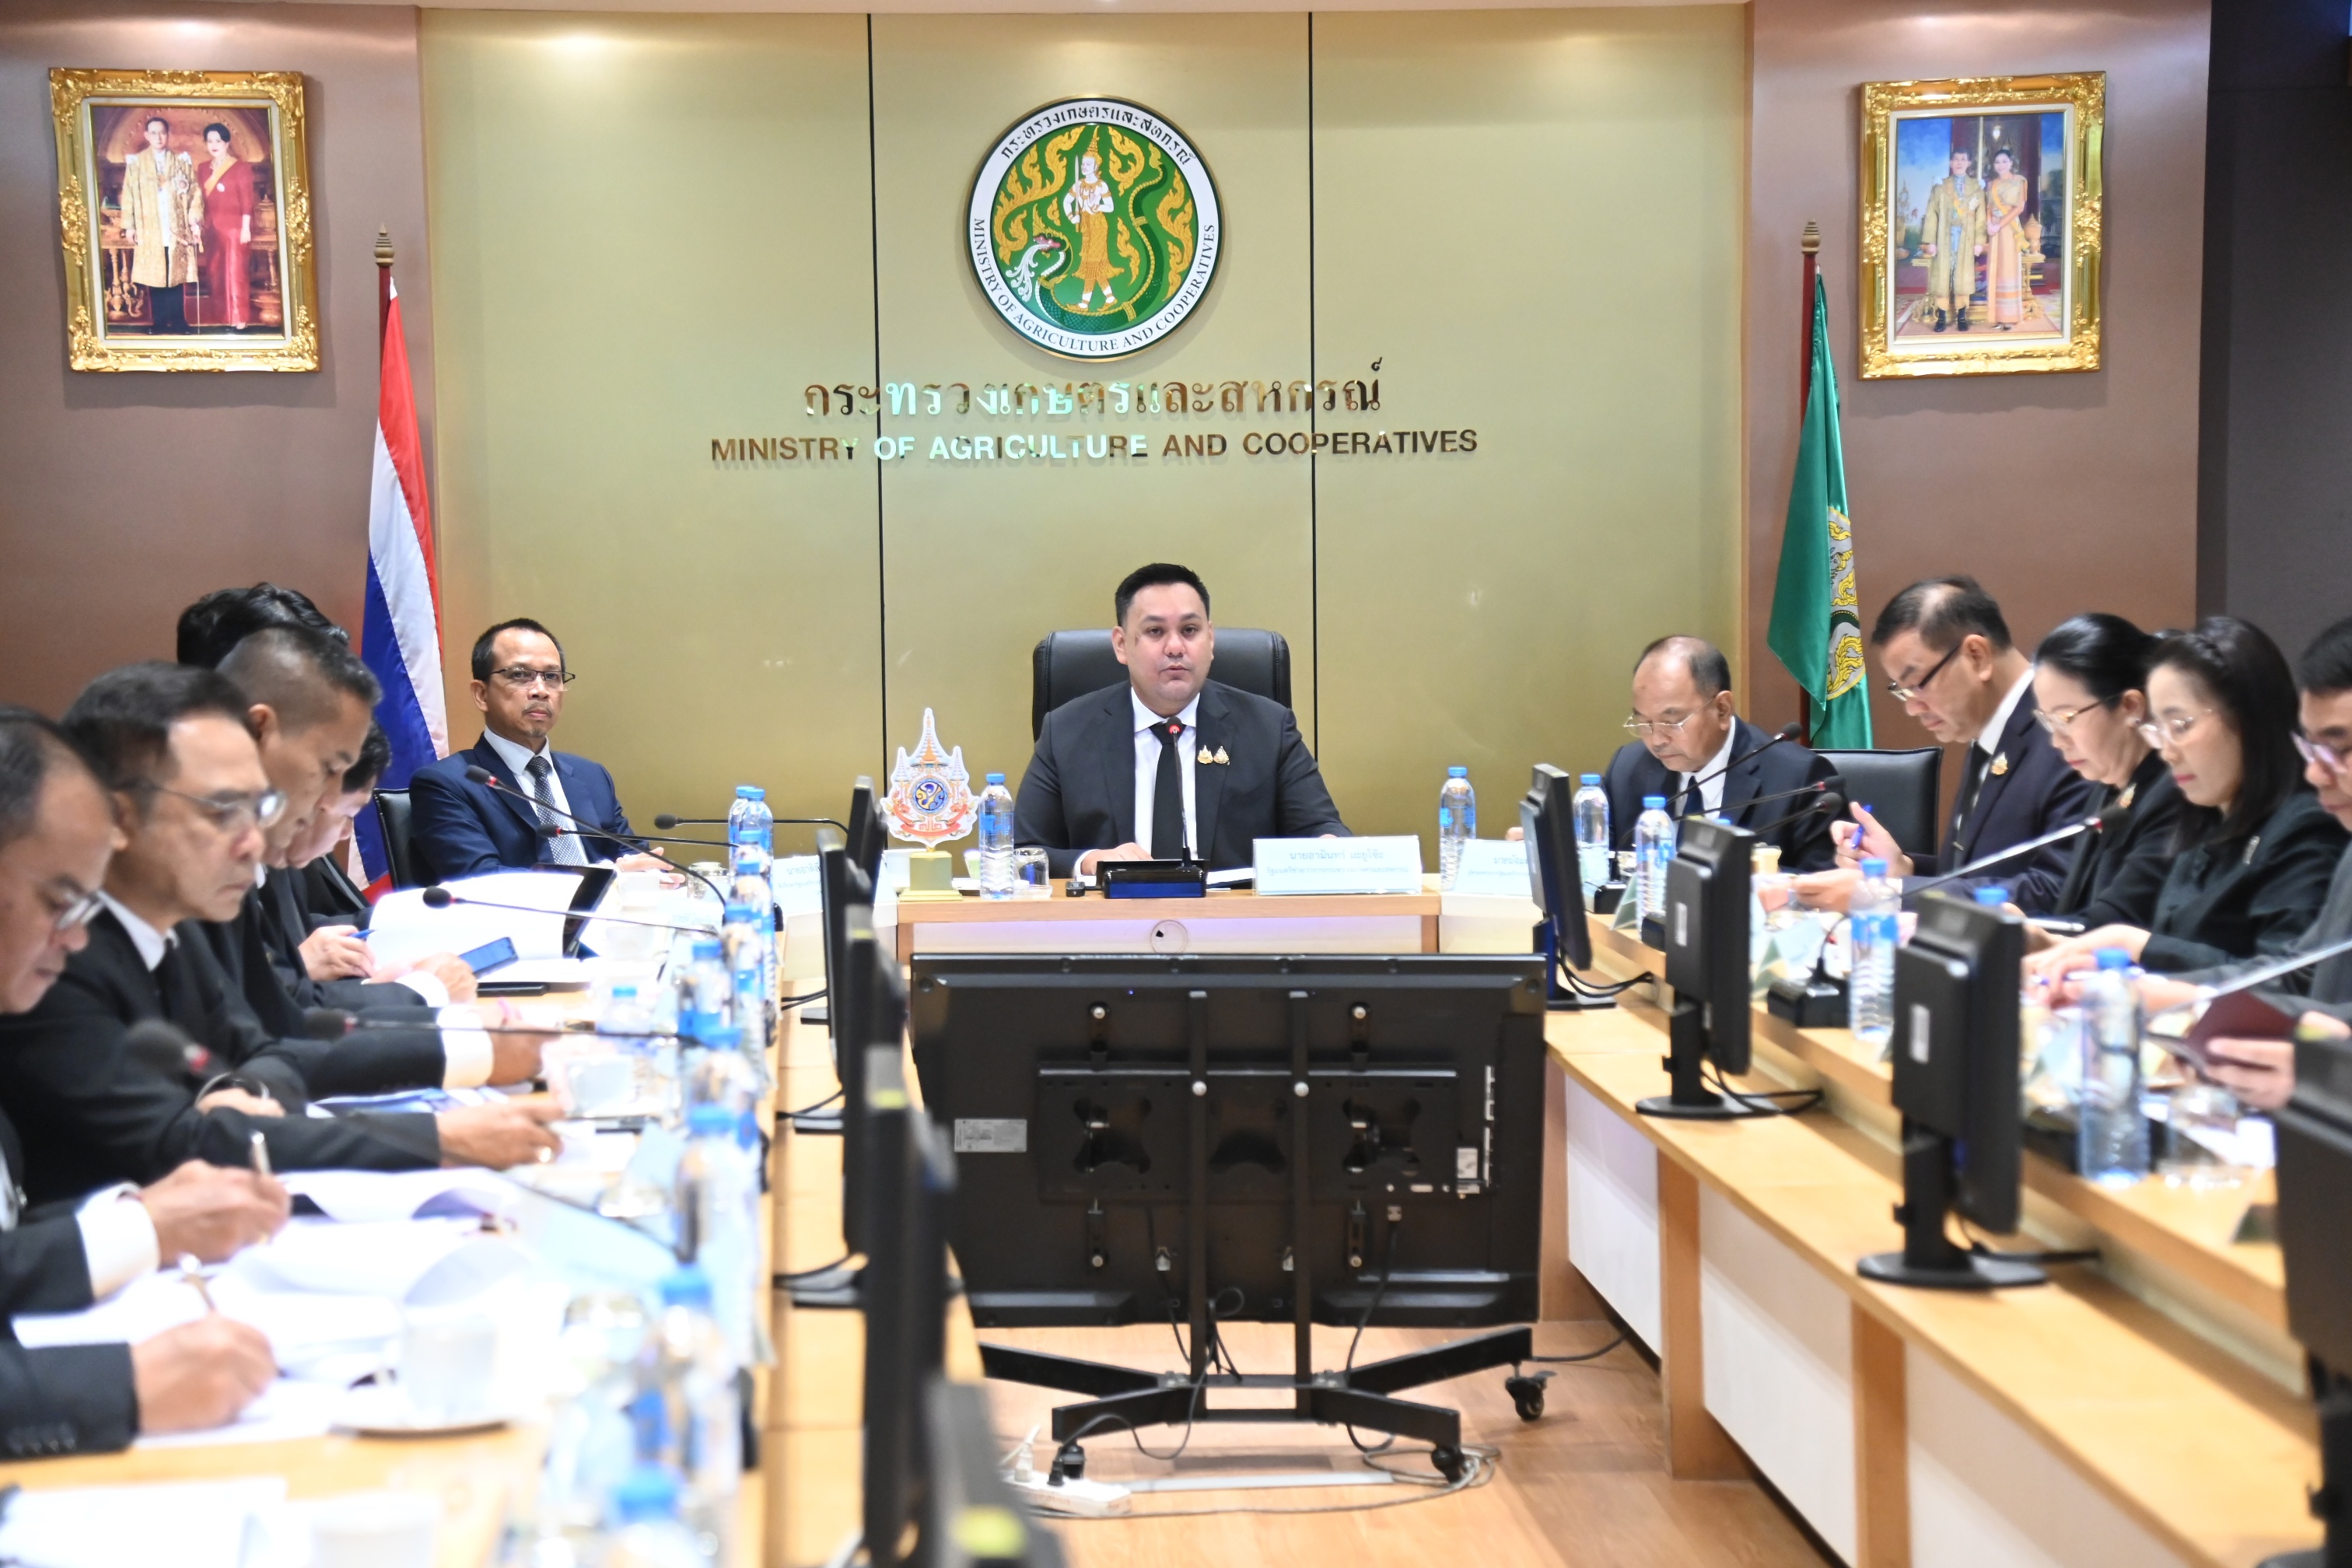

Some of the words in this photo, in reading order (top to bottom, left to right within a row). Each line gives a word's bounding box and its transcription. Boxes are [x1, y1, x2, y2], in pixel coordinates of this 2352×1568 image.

[1001, 106, 1197, 166] กระทรวงเกษตรและสหกรณ์
[974, 218, 1002, 292] MINISTRY
[998, 294, 1016, 313] OF
[1013, 311, 1118, 352] AGRICULTURE
[1122, 327, 1154, 348] AND
[1155, 224, 1216, 331] COOPERATIVES
[804, 356, 1383, 416] กระทรวงเกษตรและสหกรณ์
[712, 437, 859, 461] MINISTRY
[873, 436, 915, 460] OF
[929, 434, 1148, 460] AGRICULTURE
[1163, 434, 1227, 457] AND
[1242, 429, 1478, 456] COOPERATIVES
